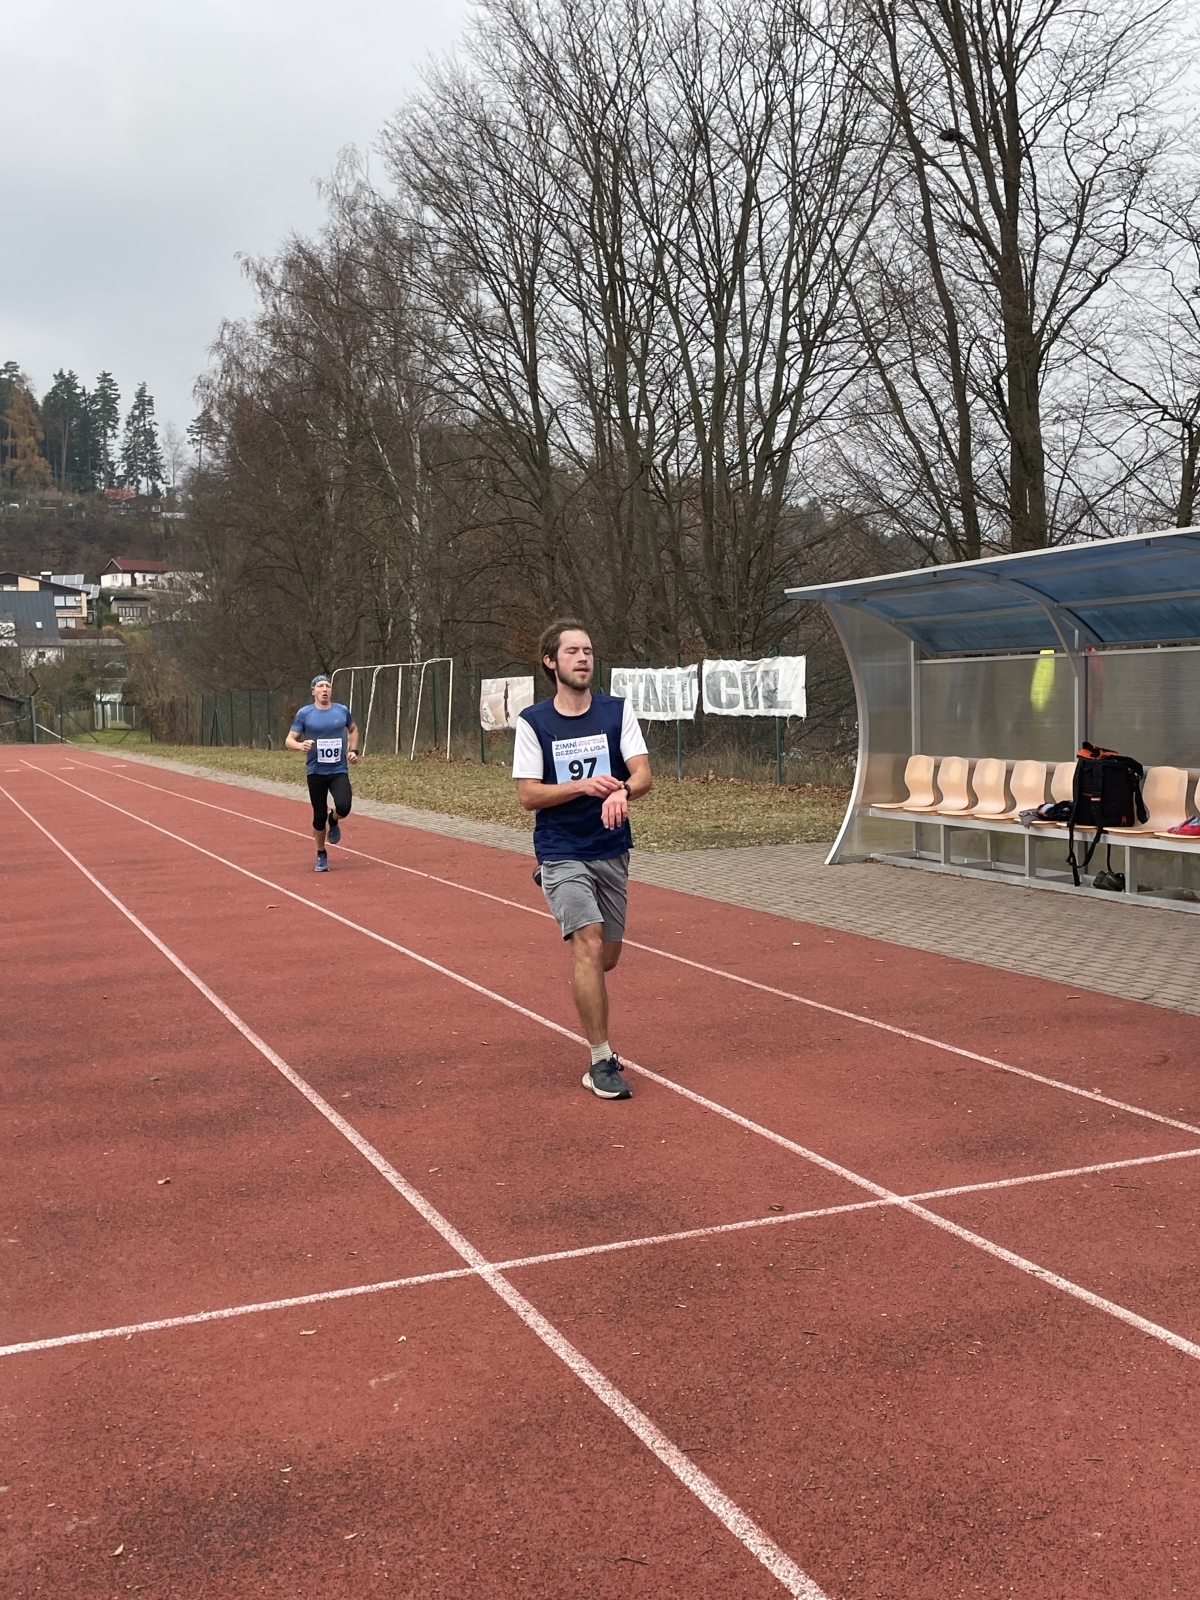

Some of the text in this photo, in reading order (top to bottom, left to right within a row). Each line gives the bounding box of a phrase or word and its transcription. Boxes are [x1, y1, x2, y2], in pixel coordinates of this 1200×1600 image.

[554, 741, 577, 750] ZIMNÍ
[590, 744, 606, 752] LIGA
[320, 748, 340, 758] 108
[568, 757, 597, 781] 97
